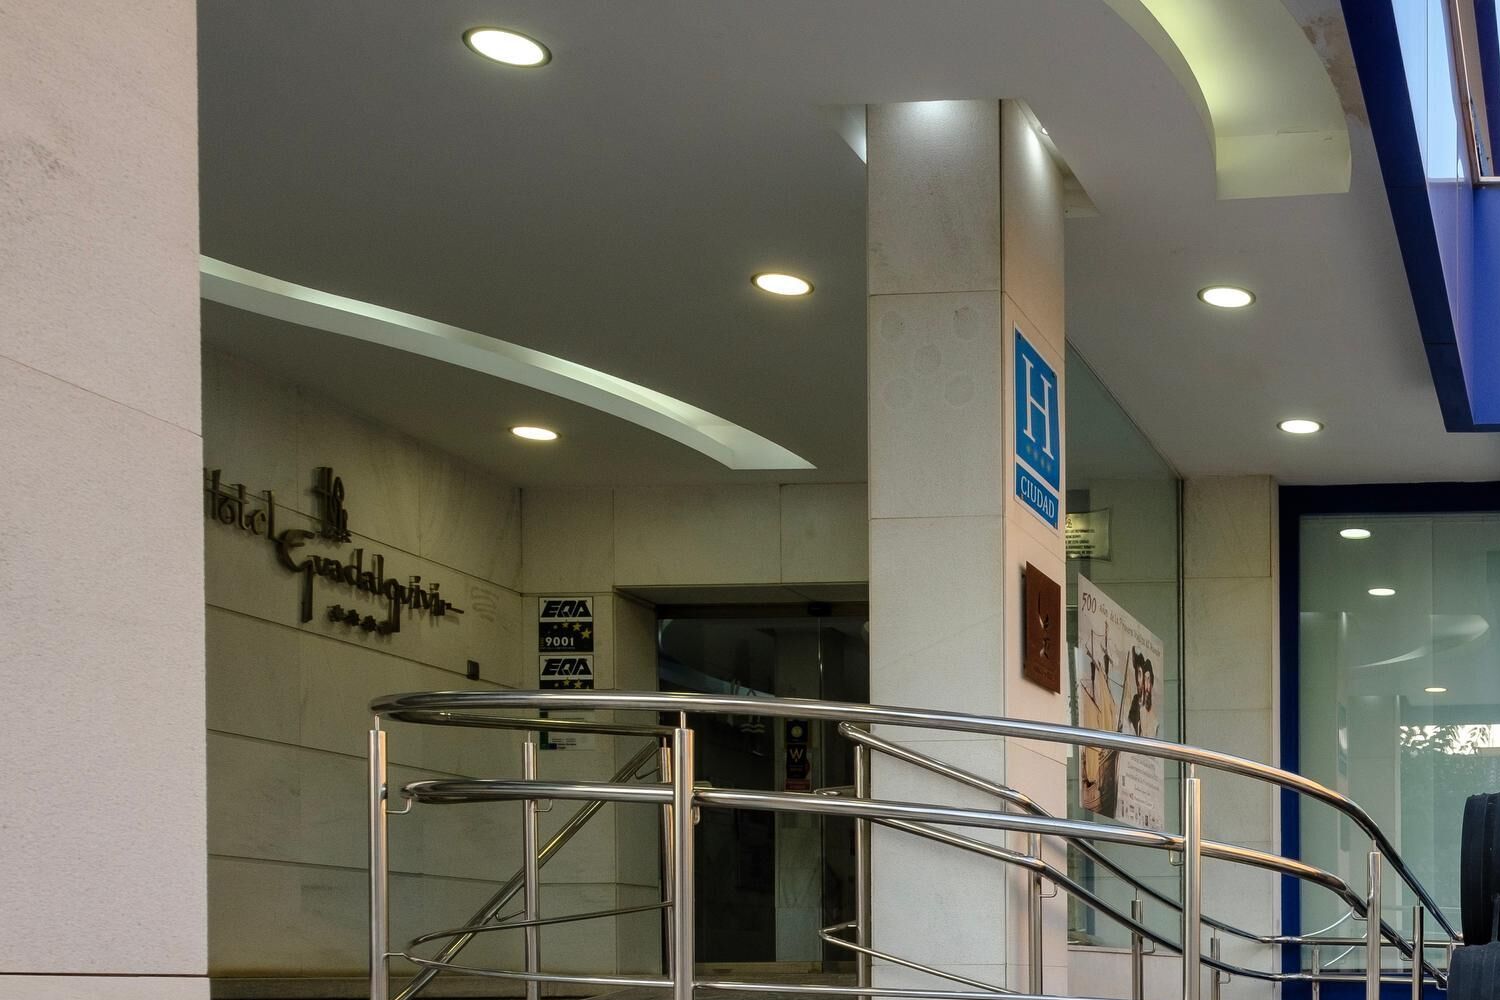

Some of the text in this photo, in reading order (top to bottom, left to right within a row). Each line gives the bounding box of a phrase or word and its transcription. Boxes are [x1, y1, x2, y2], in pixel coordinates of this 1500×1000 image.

[1022, 353, 1054, 461] H
[1020, 475, 1055, 520] CIUDAD
[541, 600, 592, 618] EQA
[1081, 592, 1097, 614] 500
[545, 636, 574, 646] 9001
[541, 658, 592, 676] EQA
